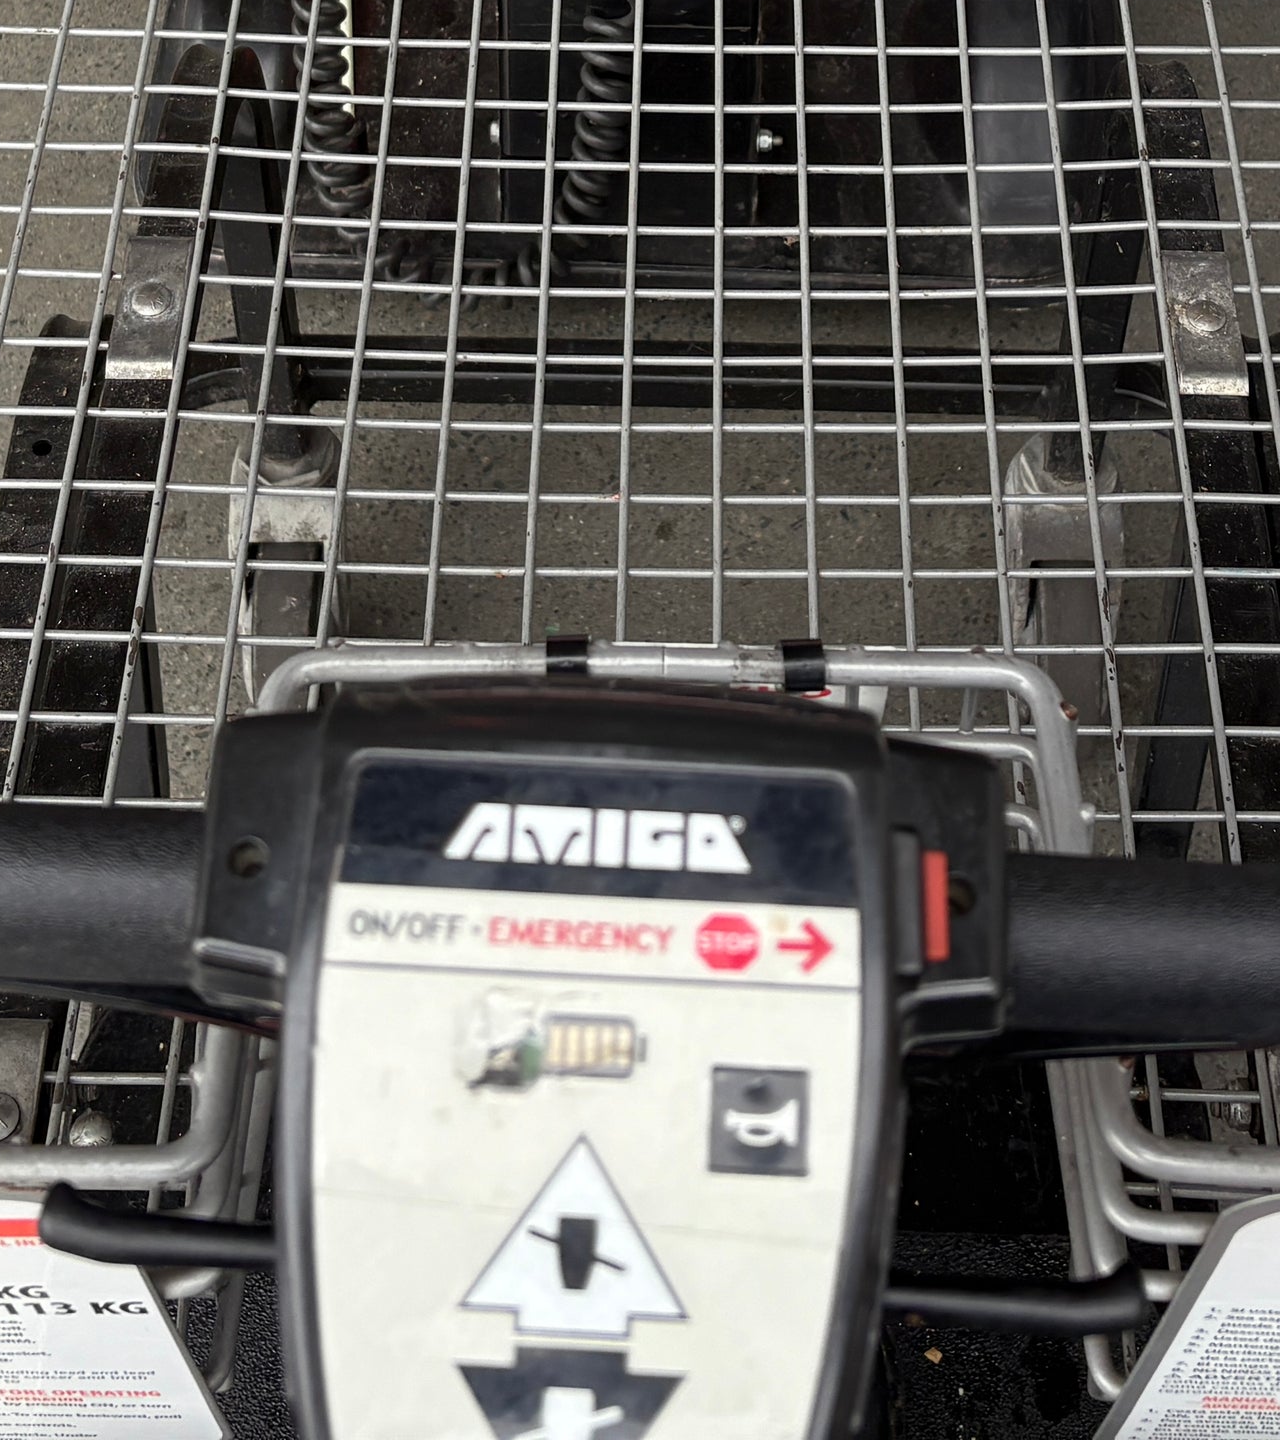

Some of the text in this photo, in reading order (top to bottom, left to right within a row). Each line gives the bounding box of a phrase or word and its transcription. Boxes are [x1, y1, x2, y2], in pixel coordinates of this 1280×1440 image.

[443, 801, 752, 875] AMIGA
[348, 909, 758, 955] ON/OFF EMERGENCY STOP
[89, 1301, 149, 1315] KG
